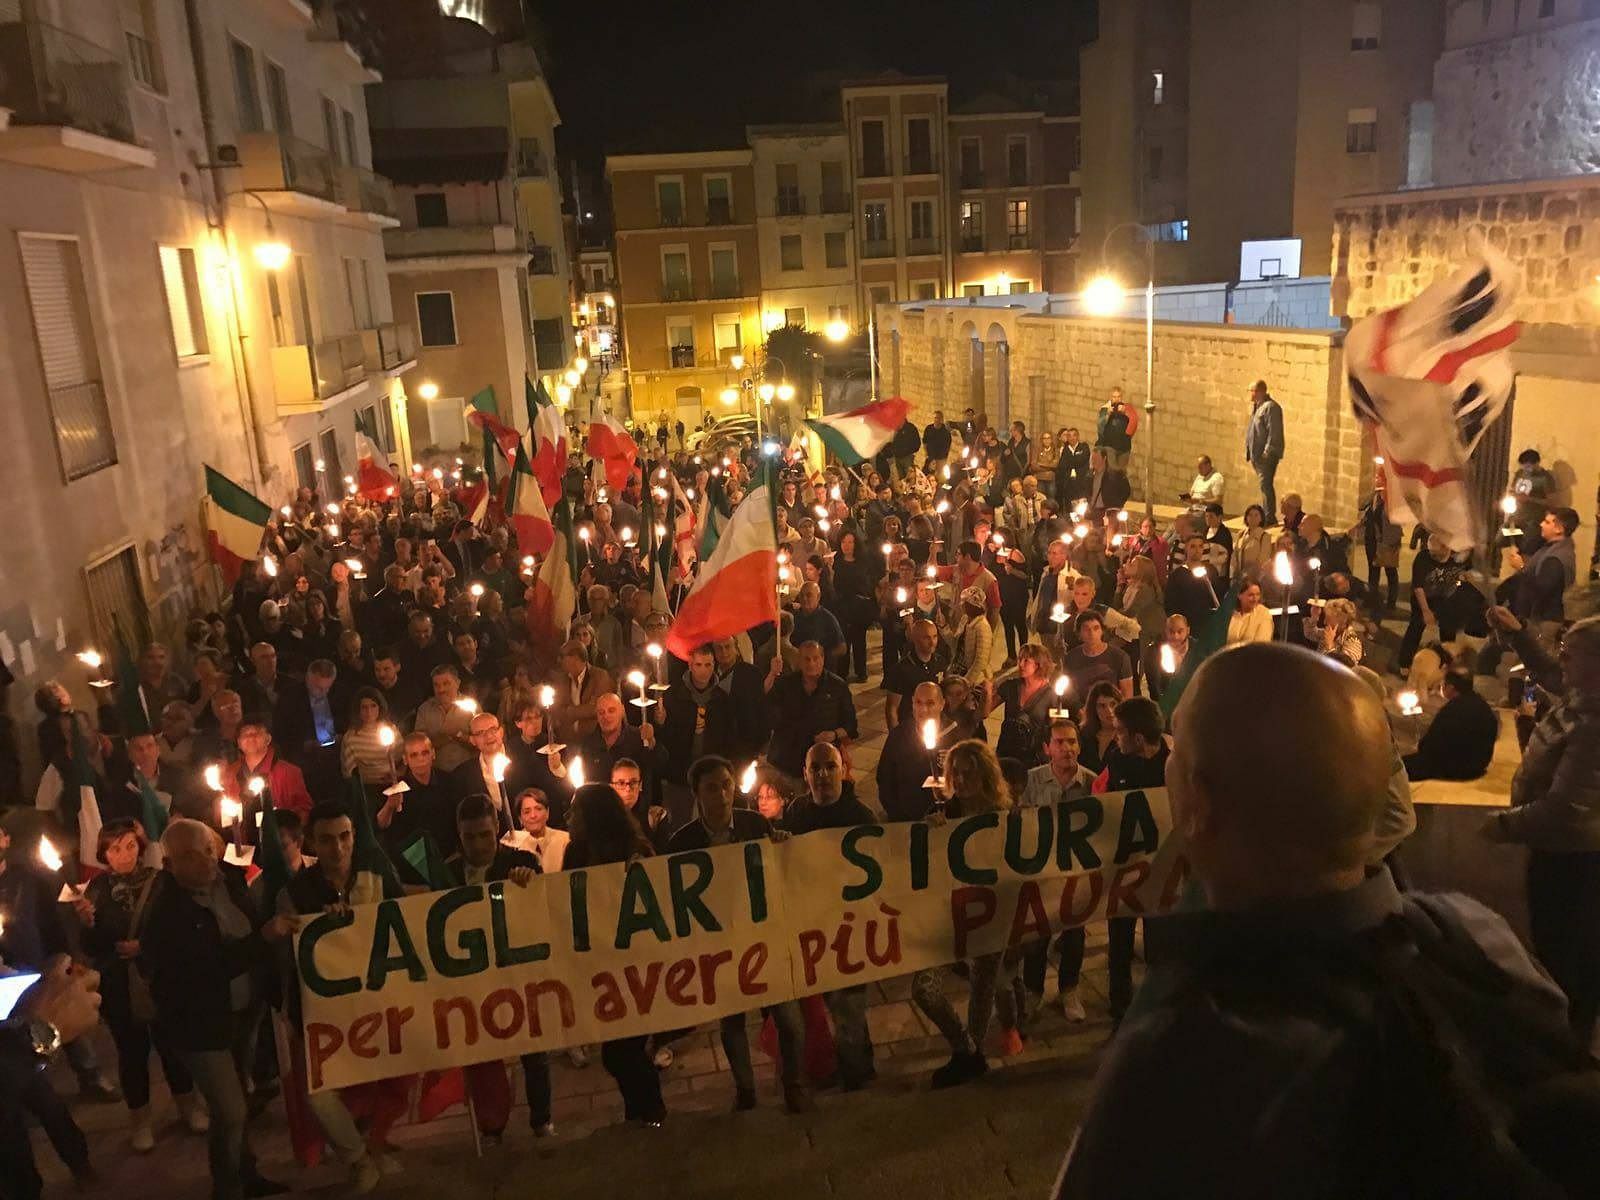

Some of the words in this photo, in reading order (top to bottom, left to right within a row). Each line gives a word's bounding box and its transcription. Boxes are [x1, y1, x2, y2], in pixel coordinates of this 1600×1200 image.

[299, 843, 768, 997] CAGLIARI
[841, 791, 1159, 901] SICURA
[306, 1004, 415, 1089] per
[433, 976, 575, 1049] non
[591, 942, 768, 1022] avere
[798, 902, 902, 987] più
